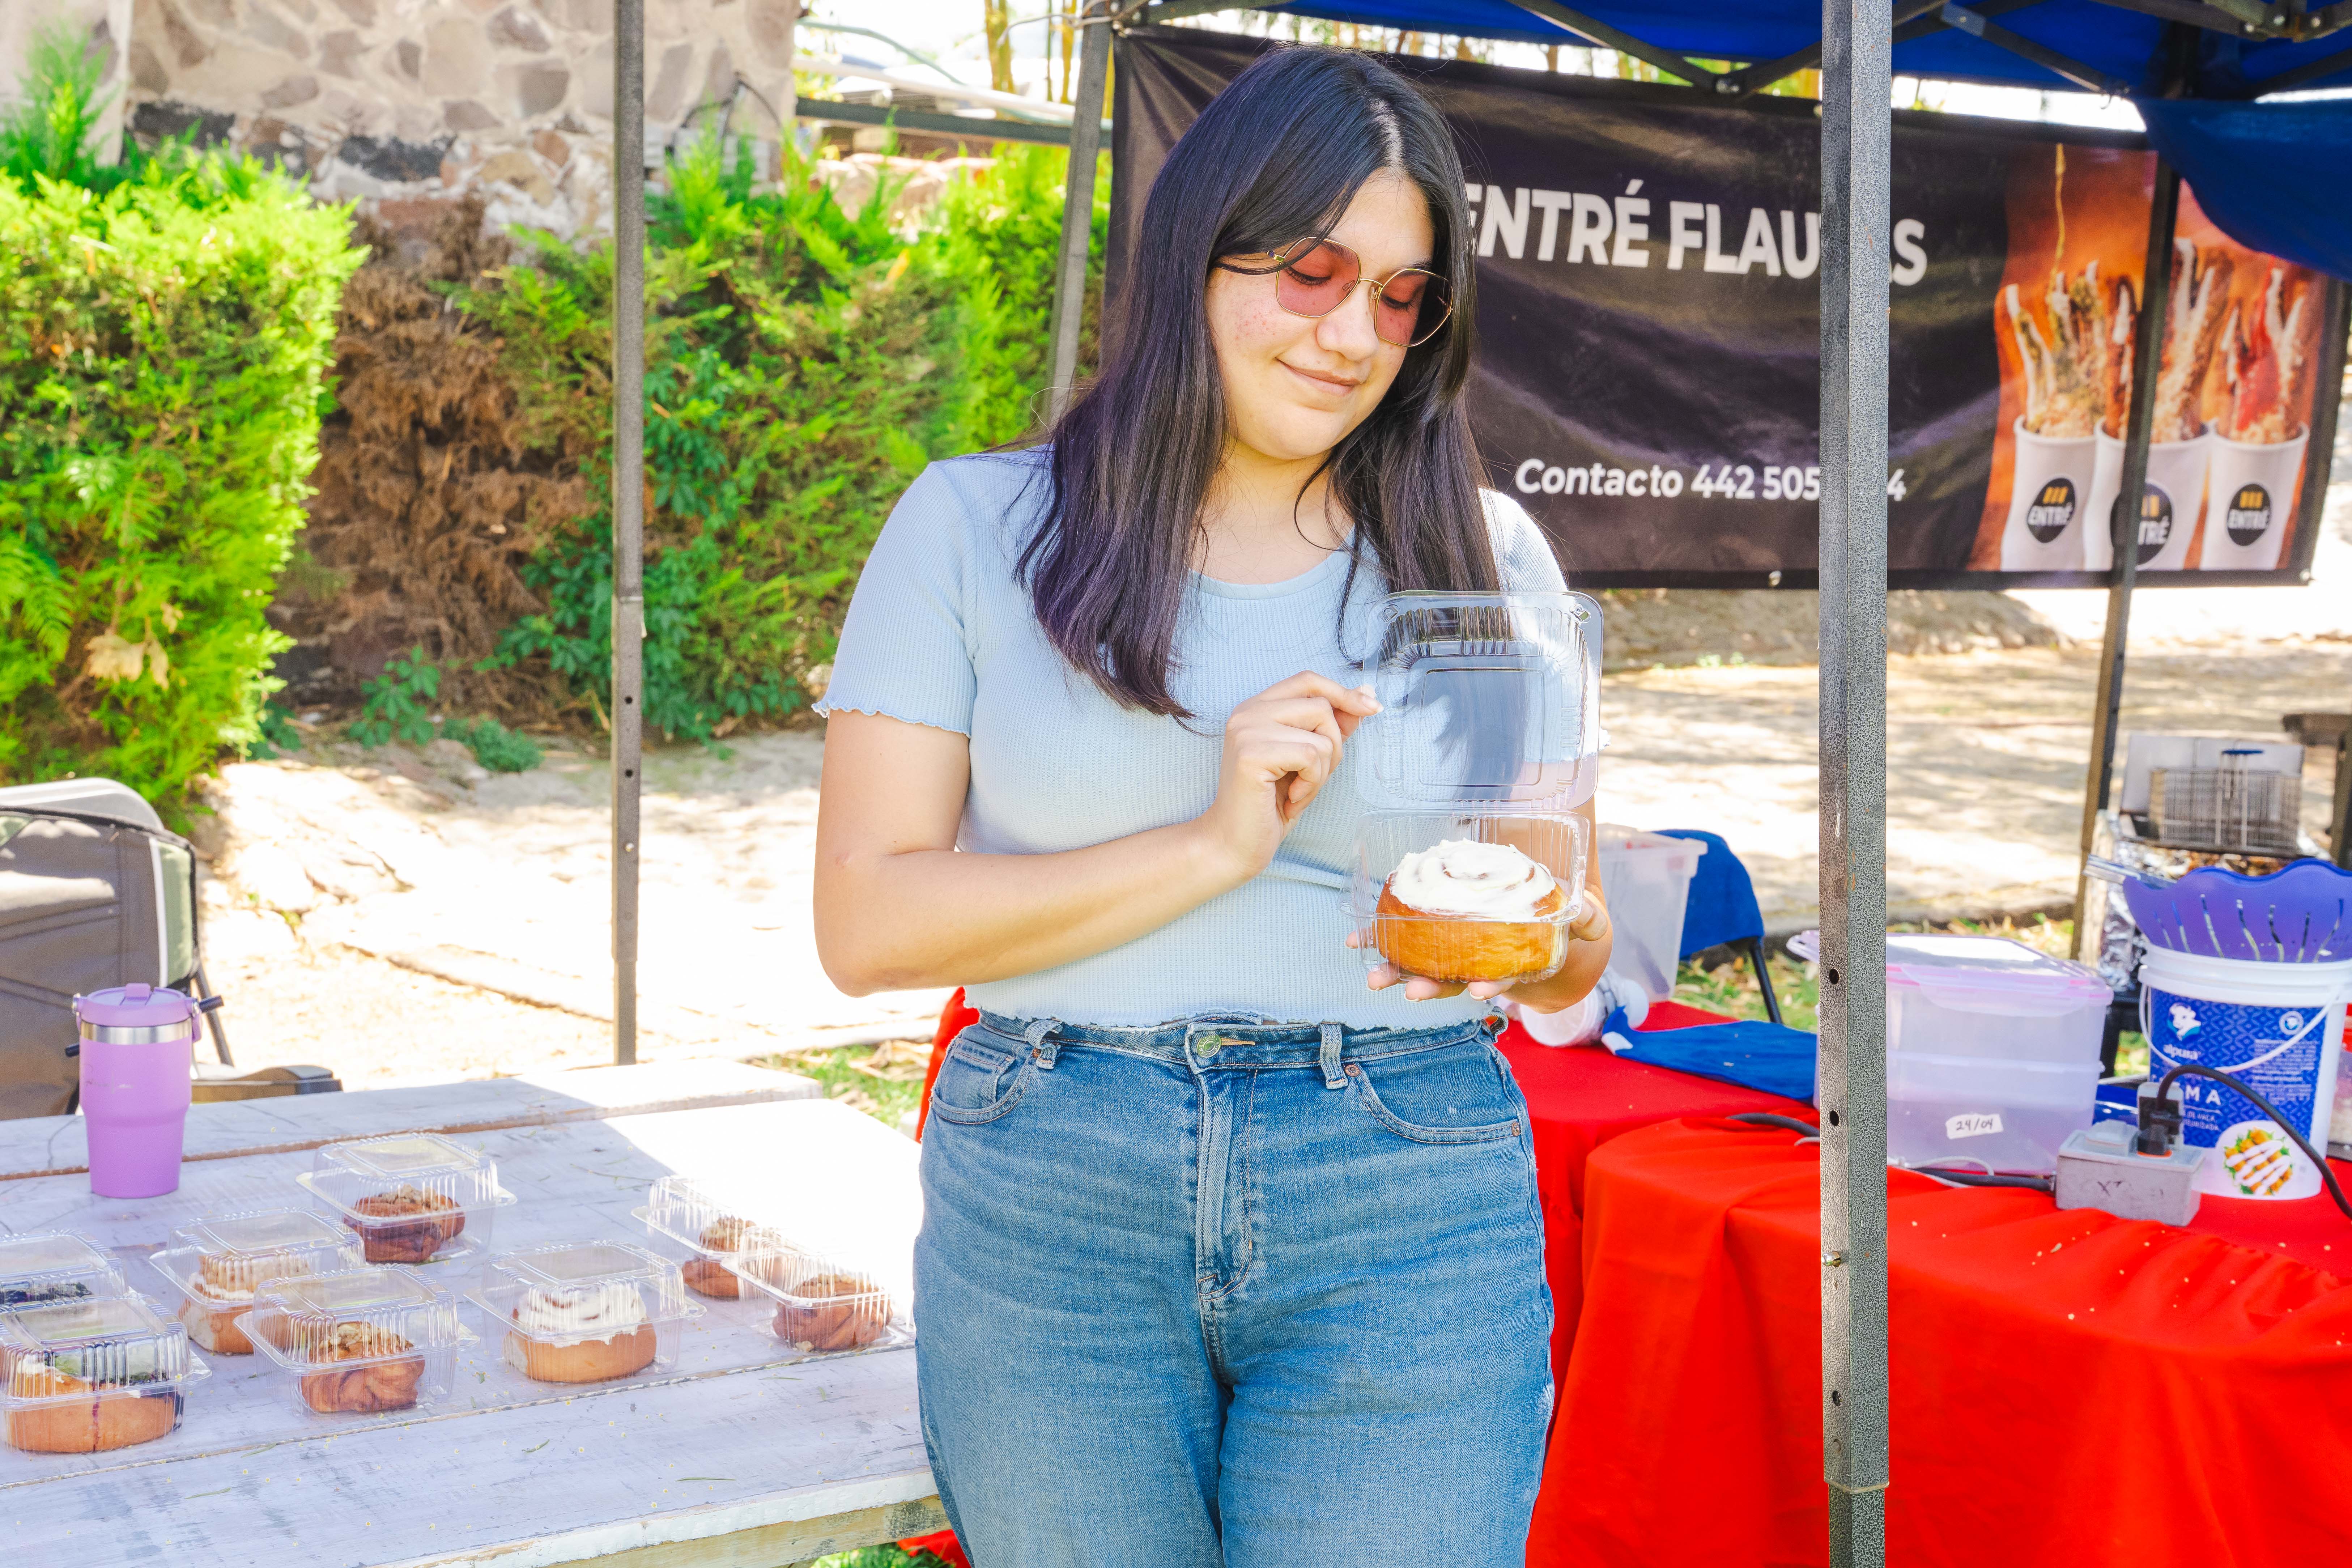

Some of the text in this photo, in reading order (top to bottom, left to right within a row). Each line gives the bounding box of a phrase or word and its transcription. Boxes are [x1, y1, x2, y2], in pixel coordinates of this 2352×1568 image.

[1667, 201, 1928, 286] FLAUS
[1515, 458, 1819, 501] Contacto 442 505
[2027, 502, 2073, 526] ENTRÉ
[2138, 515, 2170, 545] TRÉ
[1956, 1118, 1994, 1131] 24/04
